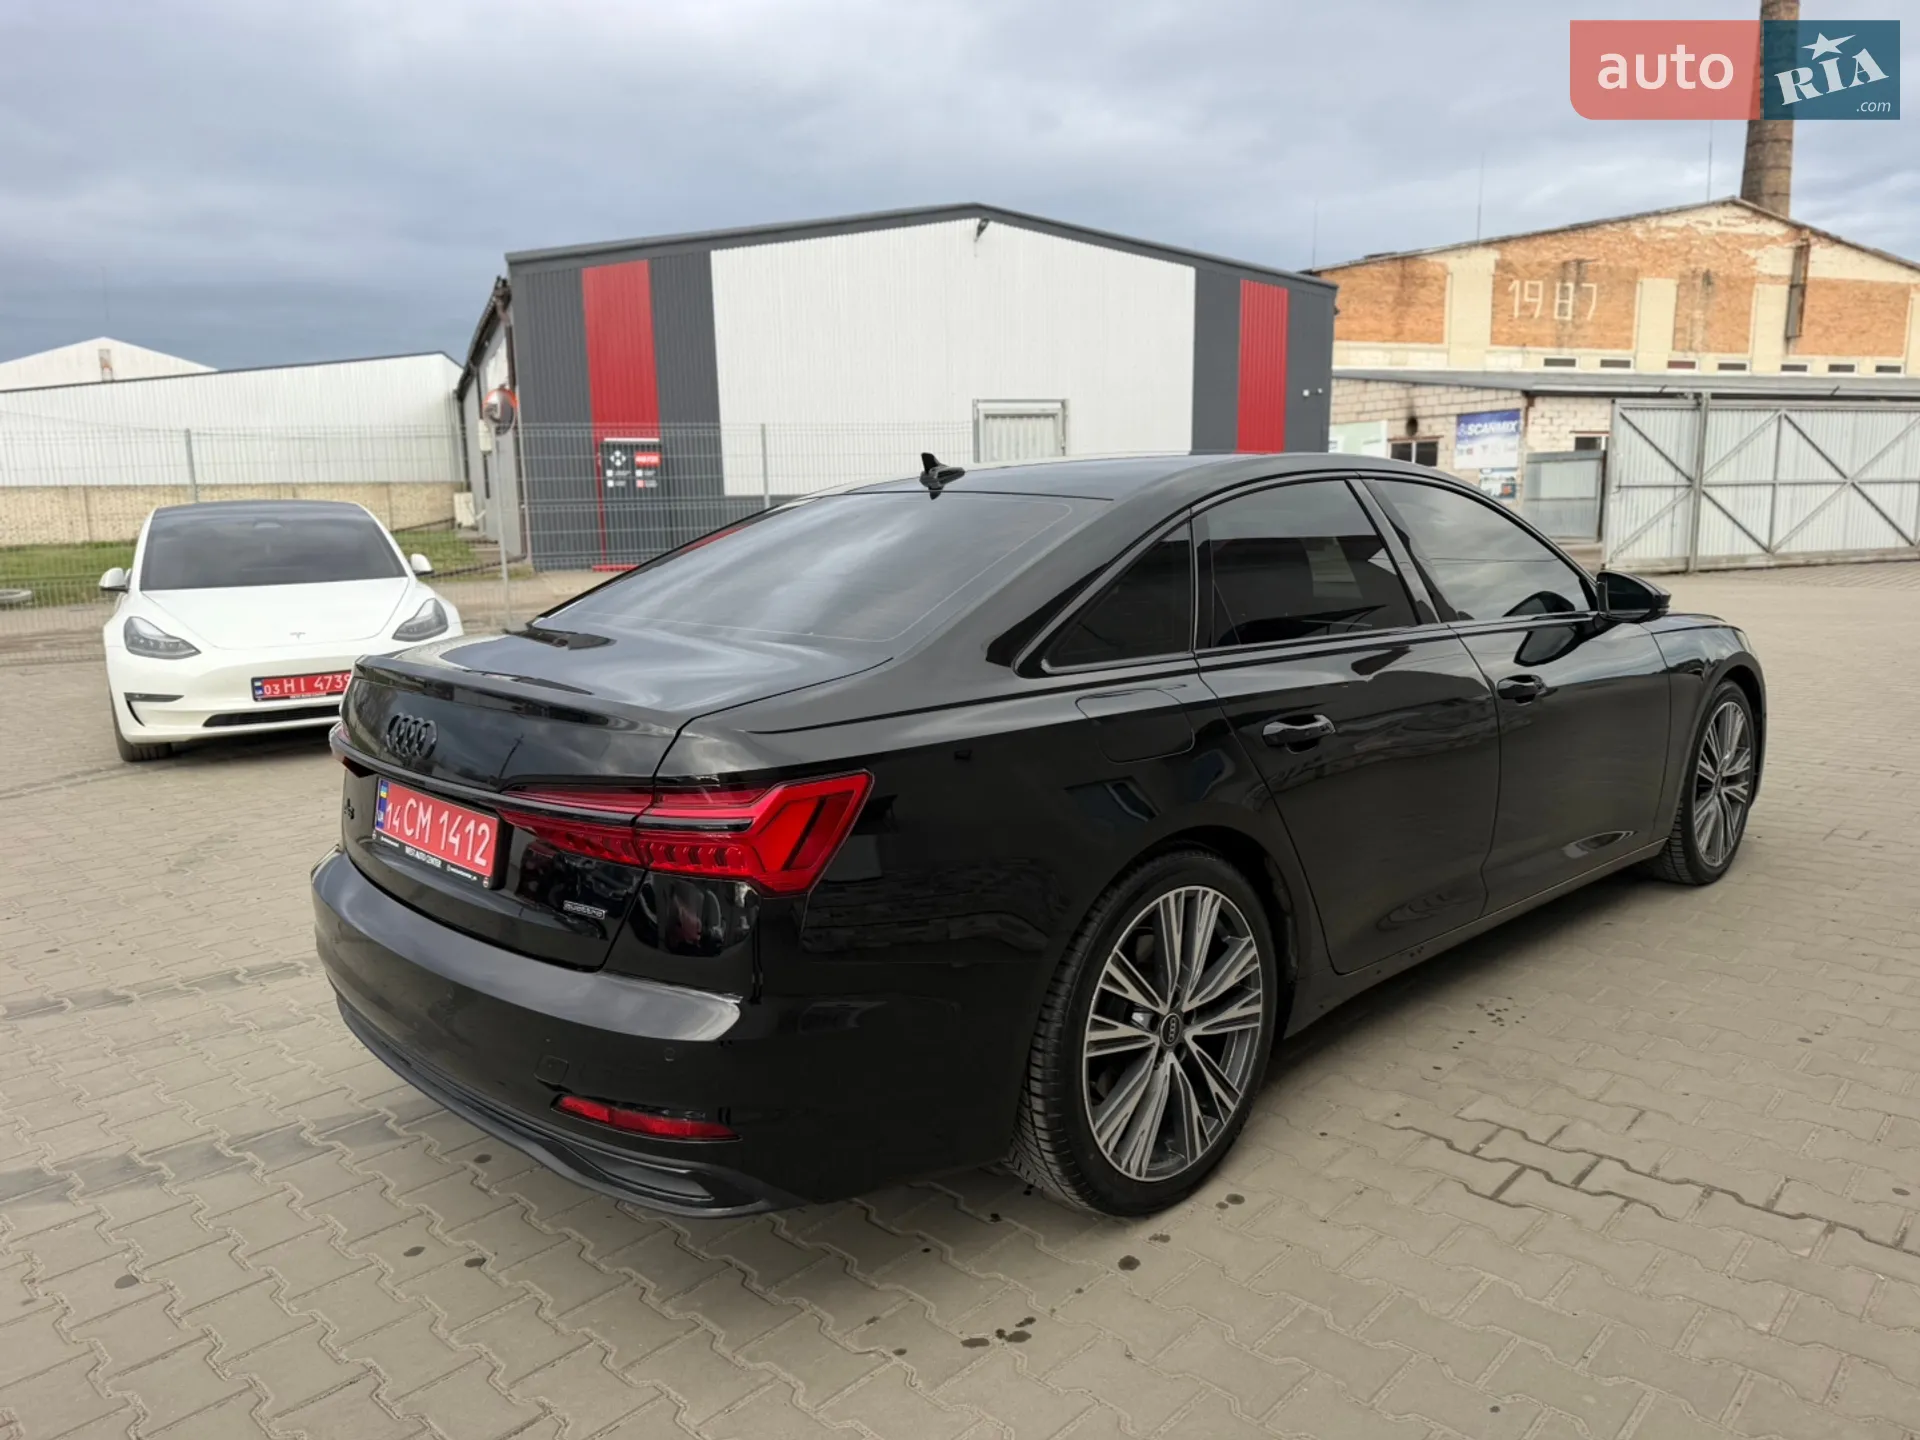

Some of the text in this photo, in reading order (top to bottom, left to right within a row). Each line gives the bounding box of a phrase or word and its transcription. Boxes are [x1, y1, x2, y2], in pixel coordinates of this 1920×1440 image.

[1508, 280, 1598, 321] 1987
[263, 684, 280, 695] 03
[314, 673, 351, 690] 4739
[385, 798, 490, 867] 14 CM 1412
